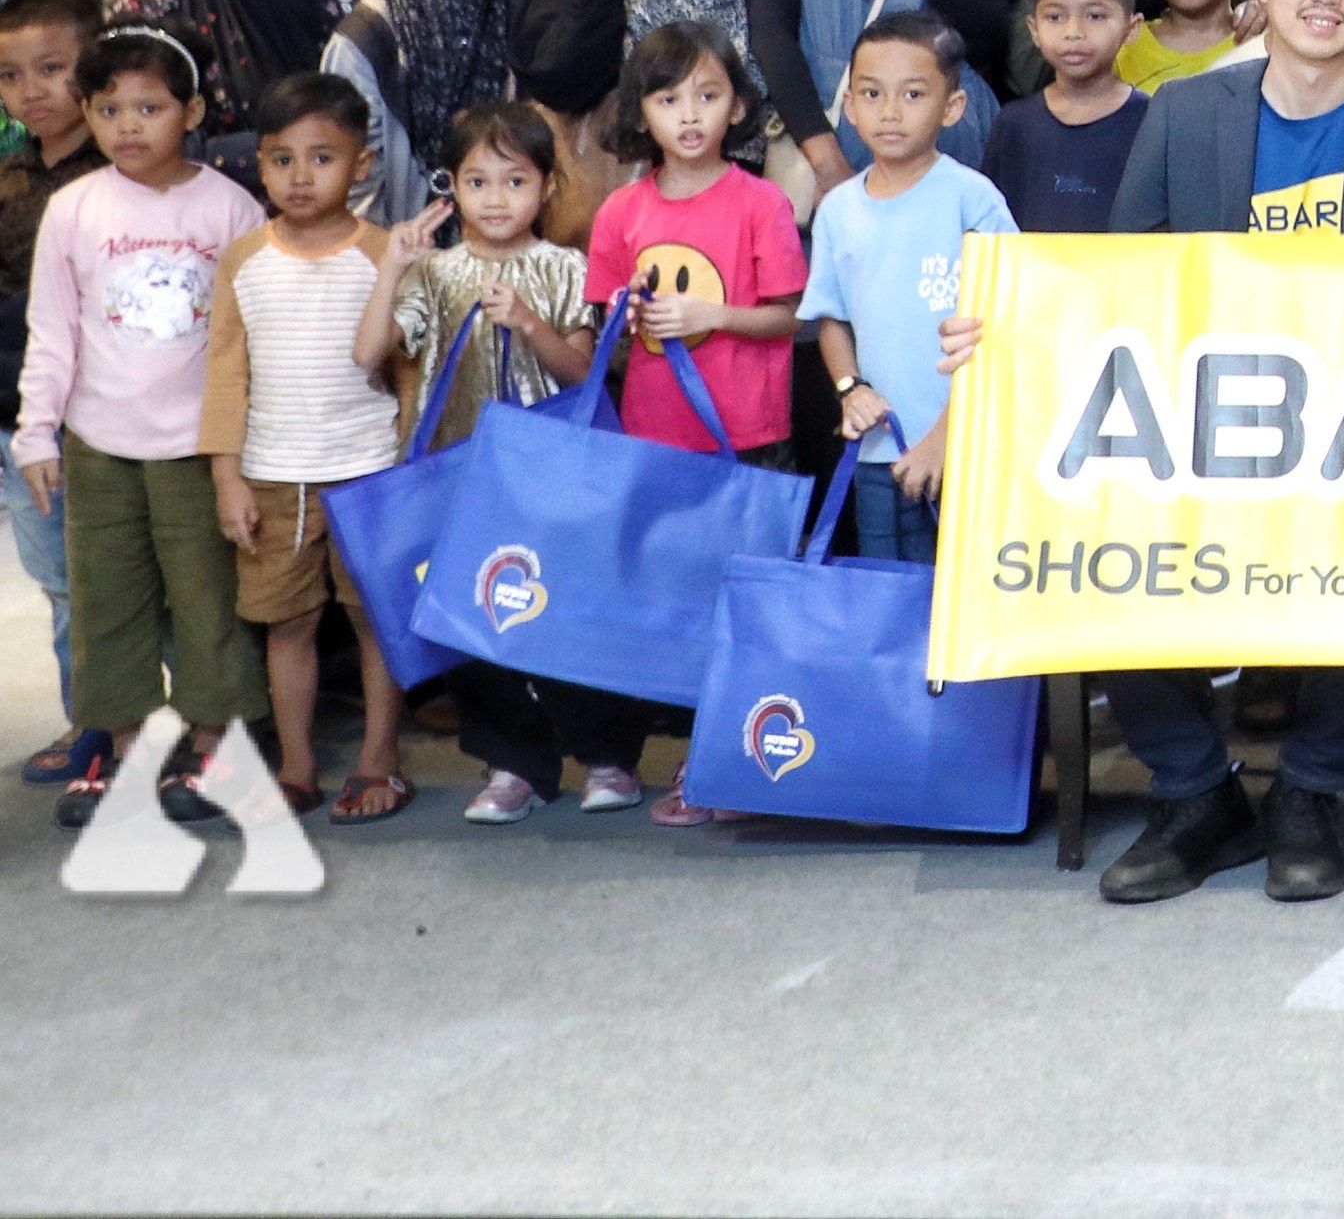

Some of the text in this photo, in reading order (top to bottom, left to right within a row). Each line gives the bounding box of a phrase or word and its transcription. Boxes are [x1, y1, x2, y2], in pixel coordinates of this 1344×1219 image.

[918, 276, 960, 299] GOO
[992, 540, 1231, 596] SHOES
[1244, 563, 1303, 595] For
